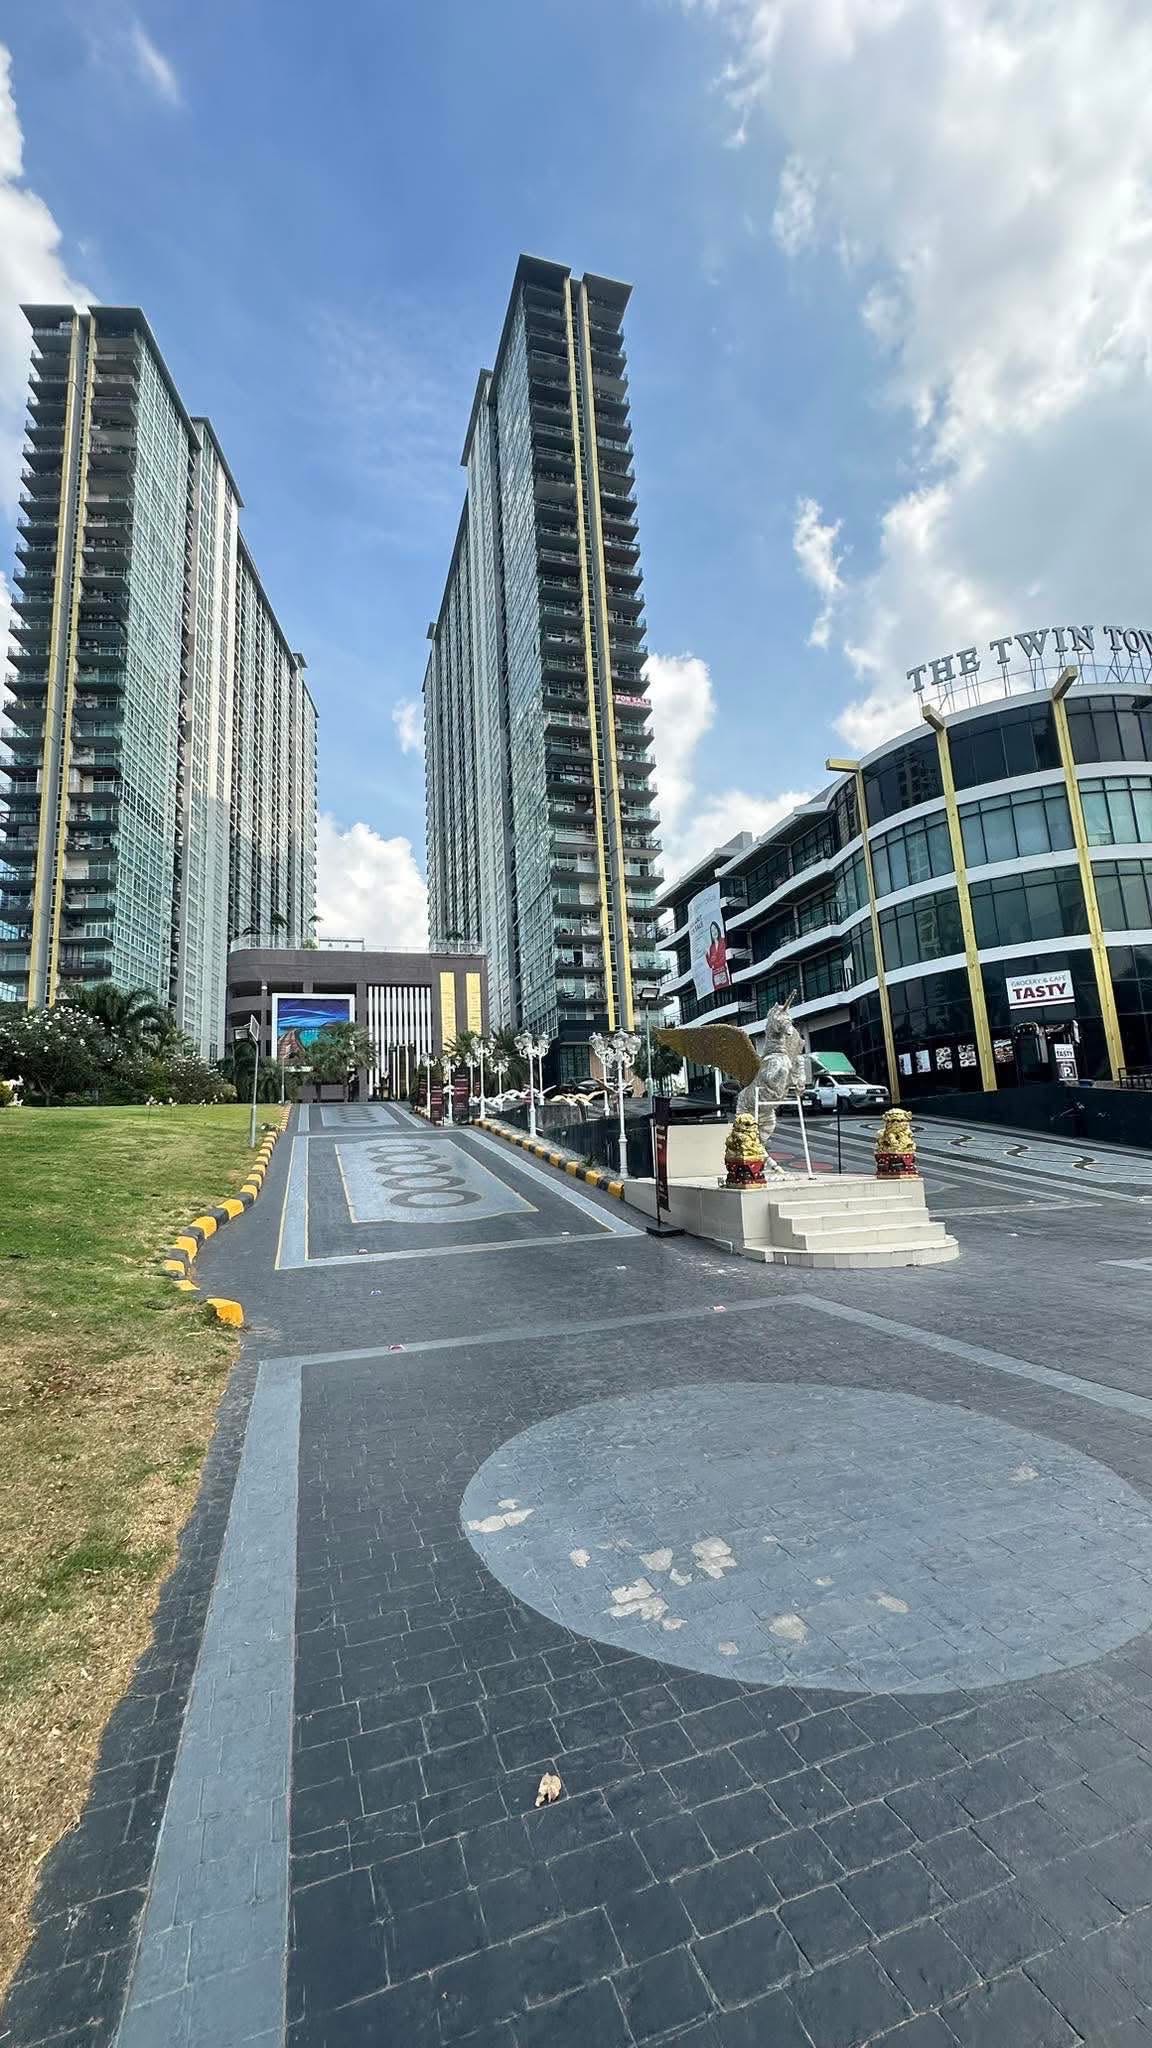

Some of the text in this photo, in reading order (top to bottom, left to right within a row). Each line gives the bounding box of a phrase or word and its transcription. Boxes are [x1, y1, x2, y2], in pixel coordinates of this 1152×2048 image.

[906, 646, 981, 693] THE
[989, 624, 1094, 665] TWIN
[616, 694, 631, 703] FOR
[1011, 978, 1041, 987] GROCERY
[1013, 983, 1066, 1000] TASTY
